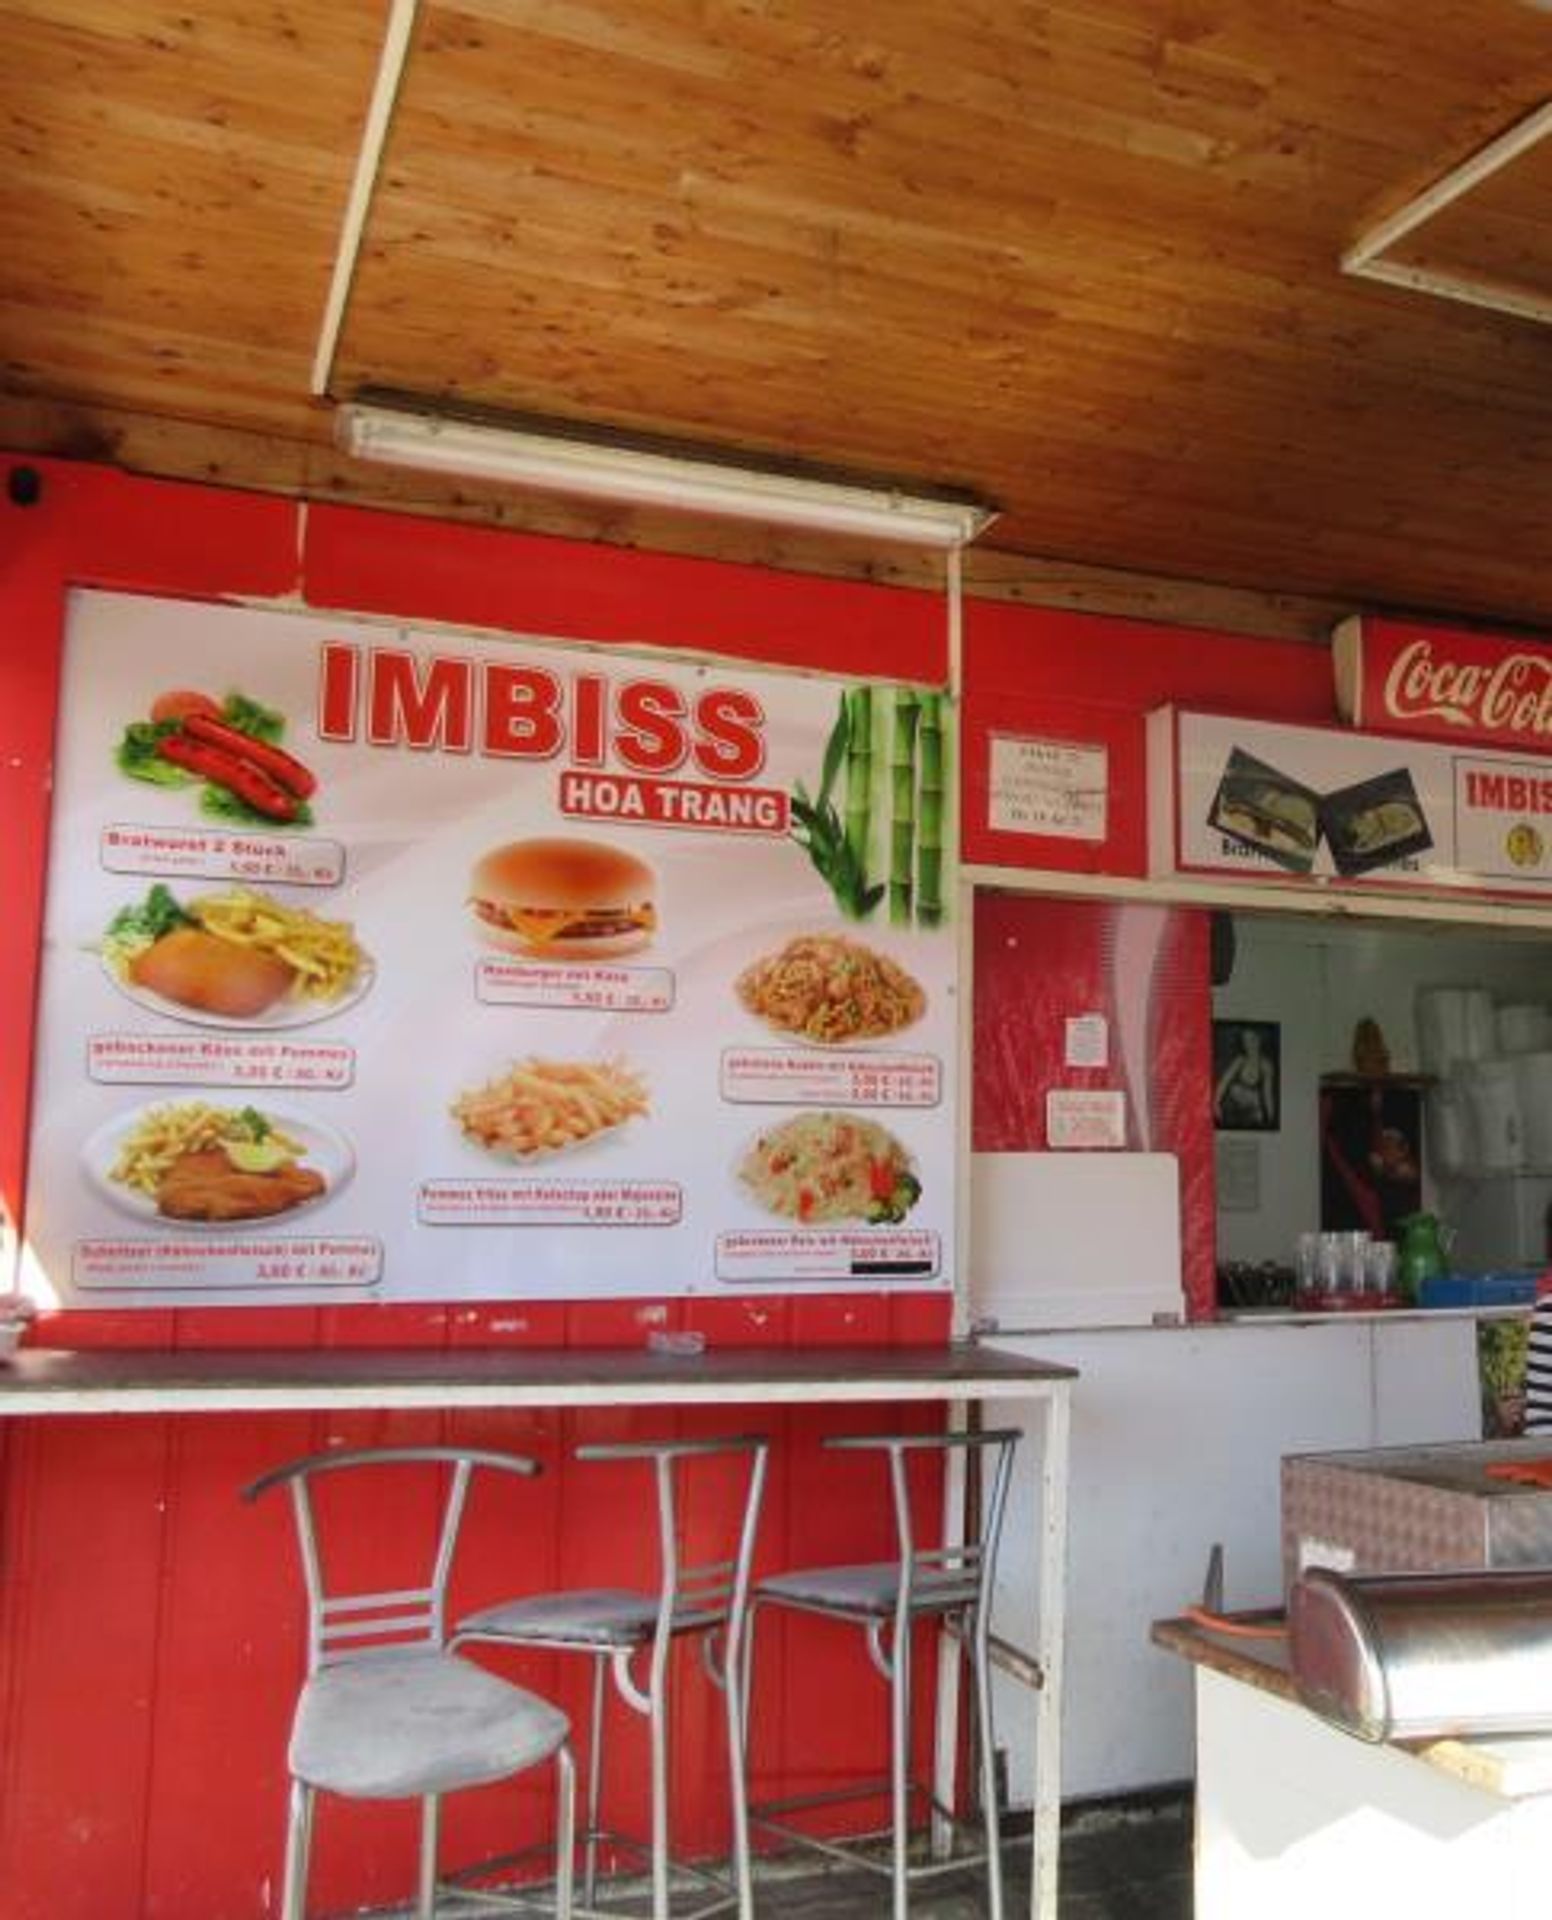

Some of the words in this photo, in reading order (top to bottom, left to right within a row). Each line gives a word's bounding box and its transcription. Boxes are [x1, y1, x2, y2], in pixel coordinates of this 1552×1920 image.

[319, 642, 765, 780] IMBISS
[1385, 640, 1552, 732] Coca-Col
[563, 777, 646, 814] HOA
[656, 785, 778, 826] TRANG
